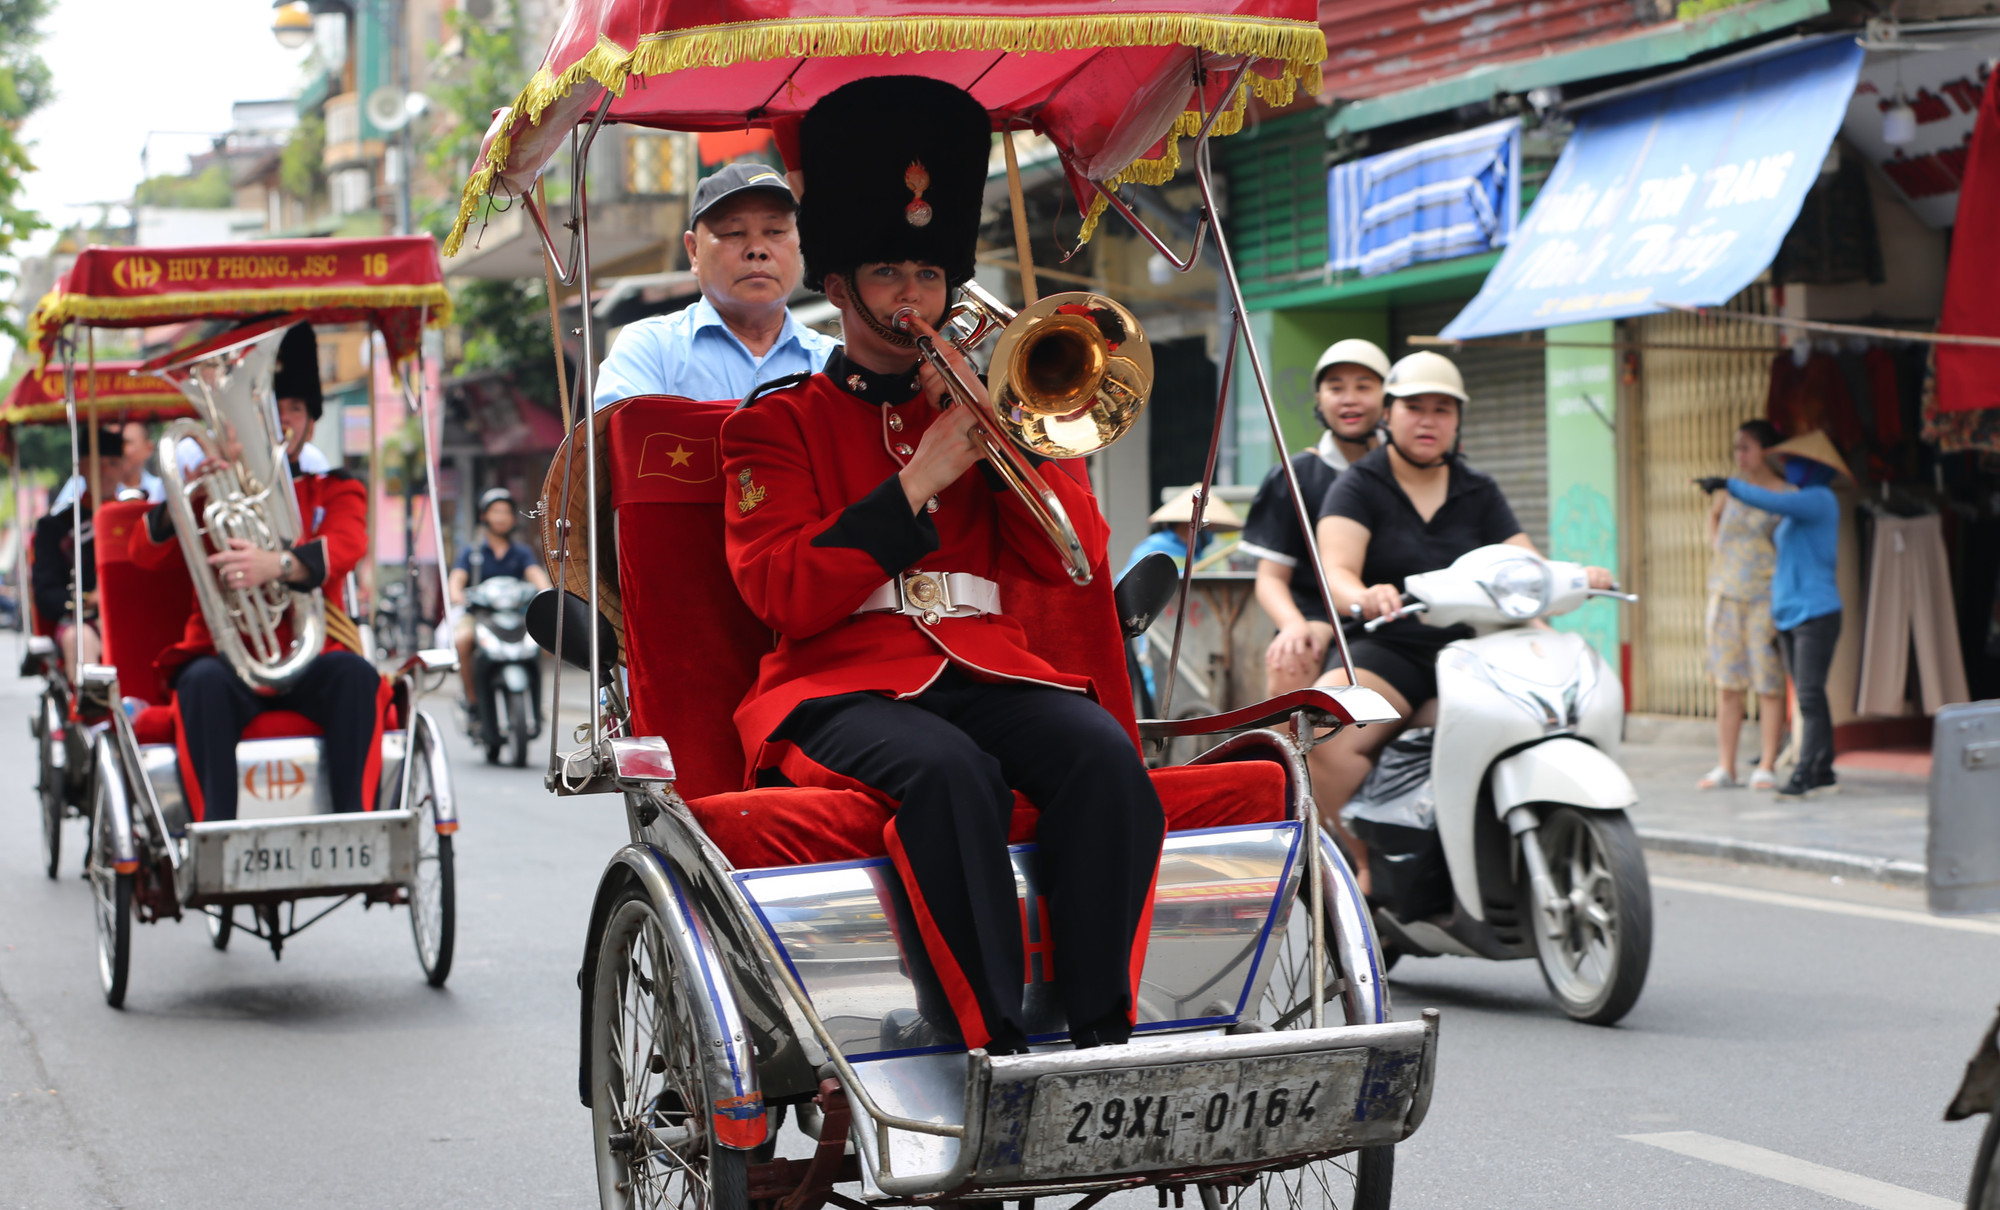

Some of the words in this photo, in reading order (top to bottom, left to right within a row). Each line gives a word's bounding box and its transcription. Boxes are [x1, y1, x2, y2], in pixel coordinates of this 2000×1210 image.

[167, 257, 212, 281] HUY
[301, 254, 338, 277] JSC
[362, 253, 389, 277] 16
[243, 848, 295, 872] 29XL
[311, 845, 371, 869] 0116
[1067, 1080, 1321, 1144] 29XL-0164
